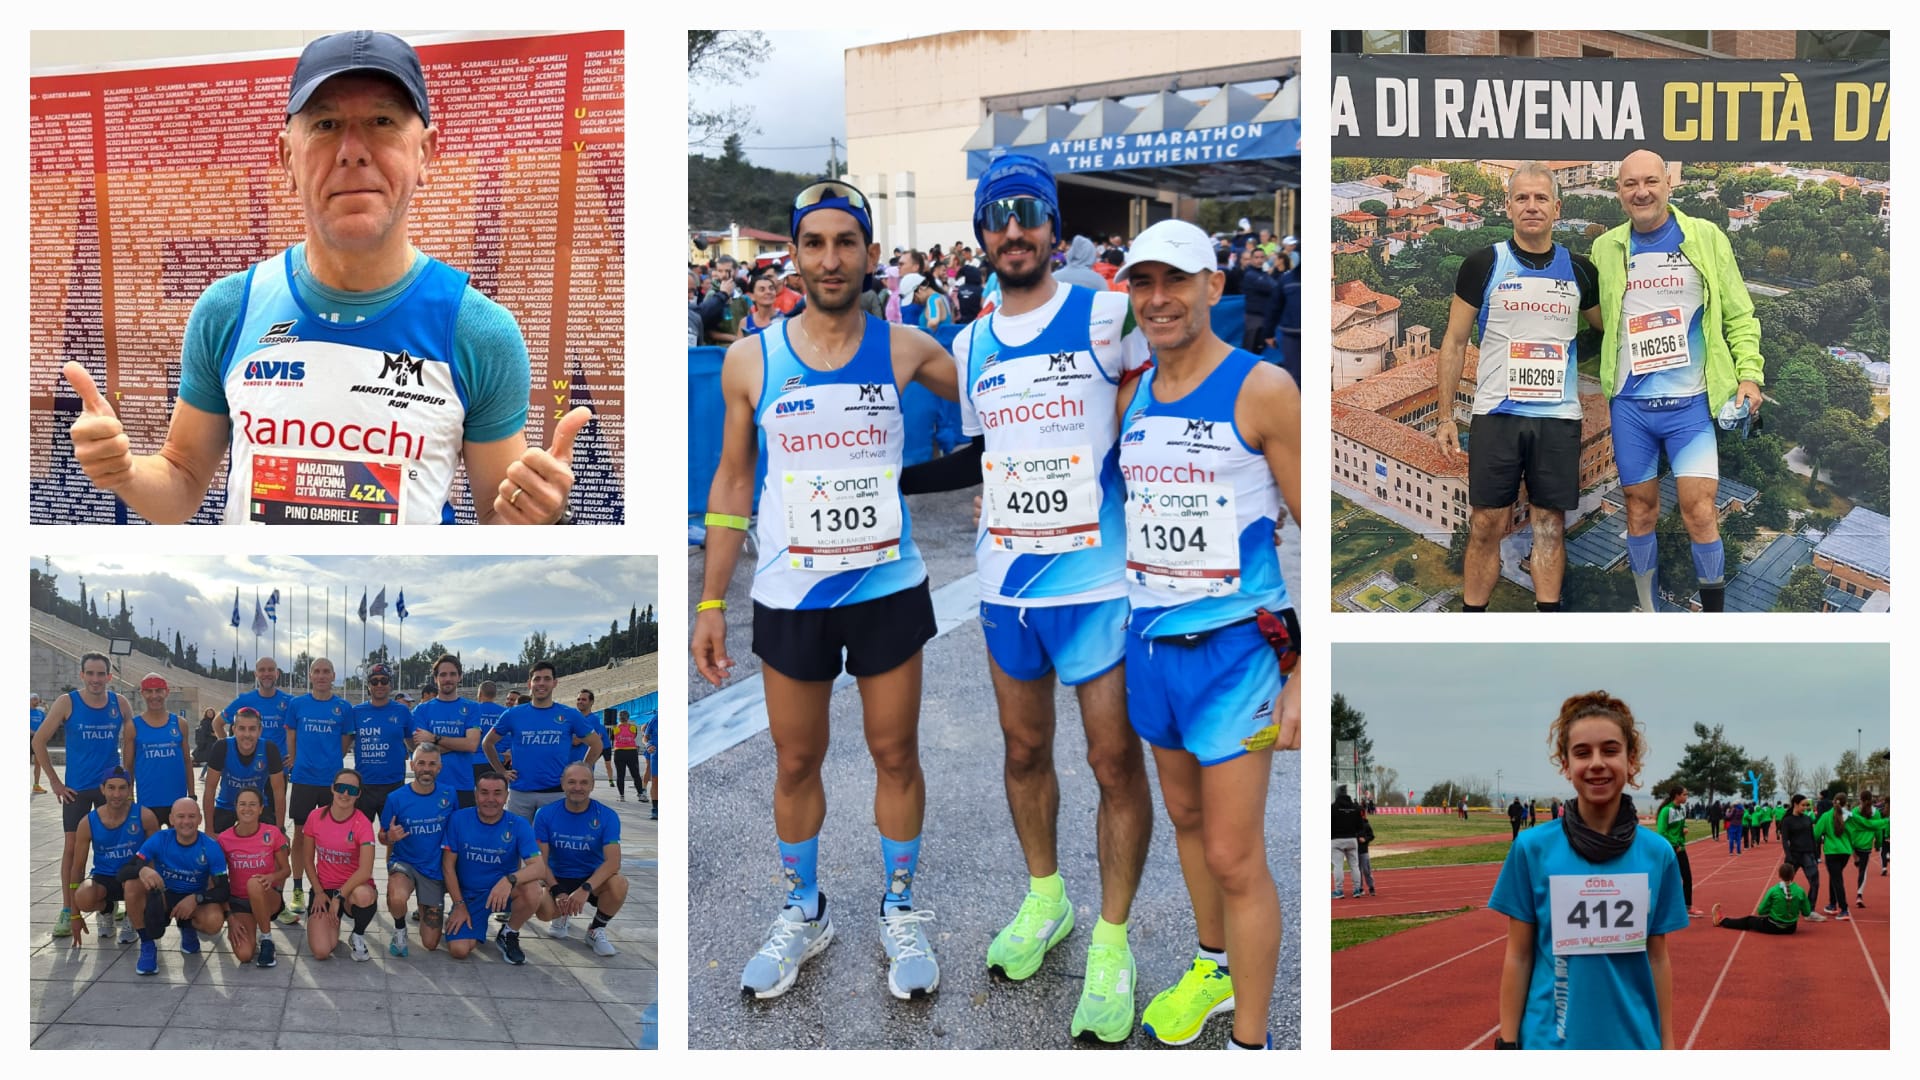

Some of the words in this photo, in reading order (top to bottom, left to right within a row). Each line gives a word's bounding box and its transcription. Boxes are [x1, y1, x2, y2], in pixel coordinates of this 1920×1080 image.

[575, 108, 586, 118] U
[1376, 77, 1420, 137] DI
[1435, 78, 1645, 141] RAVENNA
[1663, 73, 1812, 142] CITTÀ
[1049, 136, 1127, 155] ATHENS
[1136, 124, 1264, 147] MARATHON
[573, 141, 586, 152] V
[1068, 154, 1104, 170] THE
[1114, 143, 1238, 166] AUTHENTIC
[1640, 335, 1676, 357] H6256
[244, 361, 306, 380] AVIS
[1519, 368, 1554, 386] H6269
[552, 380, 568, 390] W
[977, 374, 1006, 392] AVIS
[350, 385, 394, 397] MAROTTA
[396, 391, 445, 406] MONDOLFO
[554, 395, 565, 404] Y
[388, 400, 408, 408] RUN
[776, 399, 815, 414] AVIS
[1040, 421, 1084, 434] software
[296, 462, 344, 476] MARATONA
[296, 475, 306, 486] DI
[307, 476, 346, 489] RAVENNA
[1046, 472, 1070, 480] allwyn
[295, 486, 317, 497] CITTÀ
[319, 488, 346, 499] D'ARTE
[1007, 489, 1068, 513] 4209
[285, 505, 308, 519] PINO
[310, 507, 359, 523] GABRIELE
[811, 506, 877, 532] 1303
[1181, 510, 1208, 518] allwyn
[1141, 524, 1207, 552] 1304
[82, 730, 114, 740] ITALIA
[304, 724, 332, 733] ITALIA
[360, 728, 380, 736] RUN
[522, 735, 560, 745] ITALIA
[145, 748, 176, 759] ITALIA
[410, 824, 442, 835] ITALIA
[555, 840, 590, 851] ITALIA
[233, 860, 266, 868] ITALIA
[466, 851, 502, 864] ITALIA
[1567, 900, 1634, 928] 412
